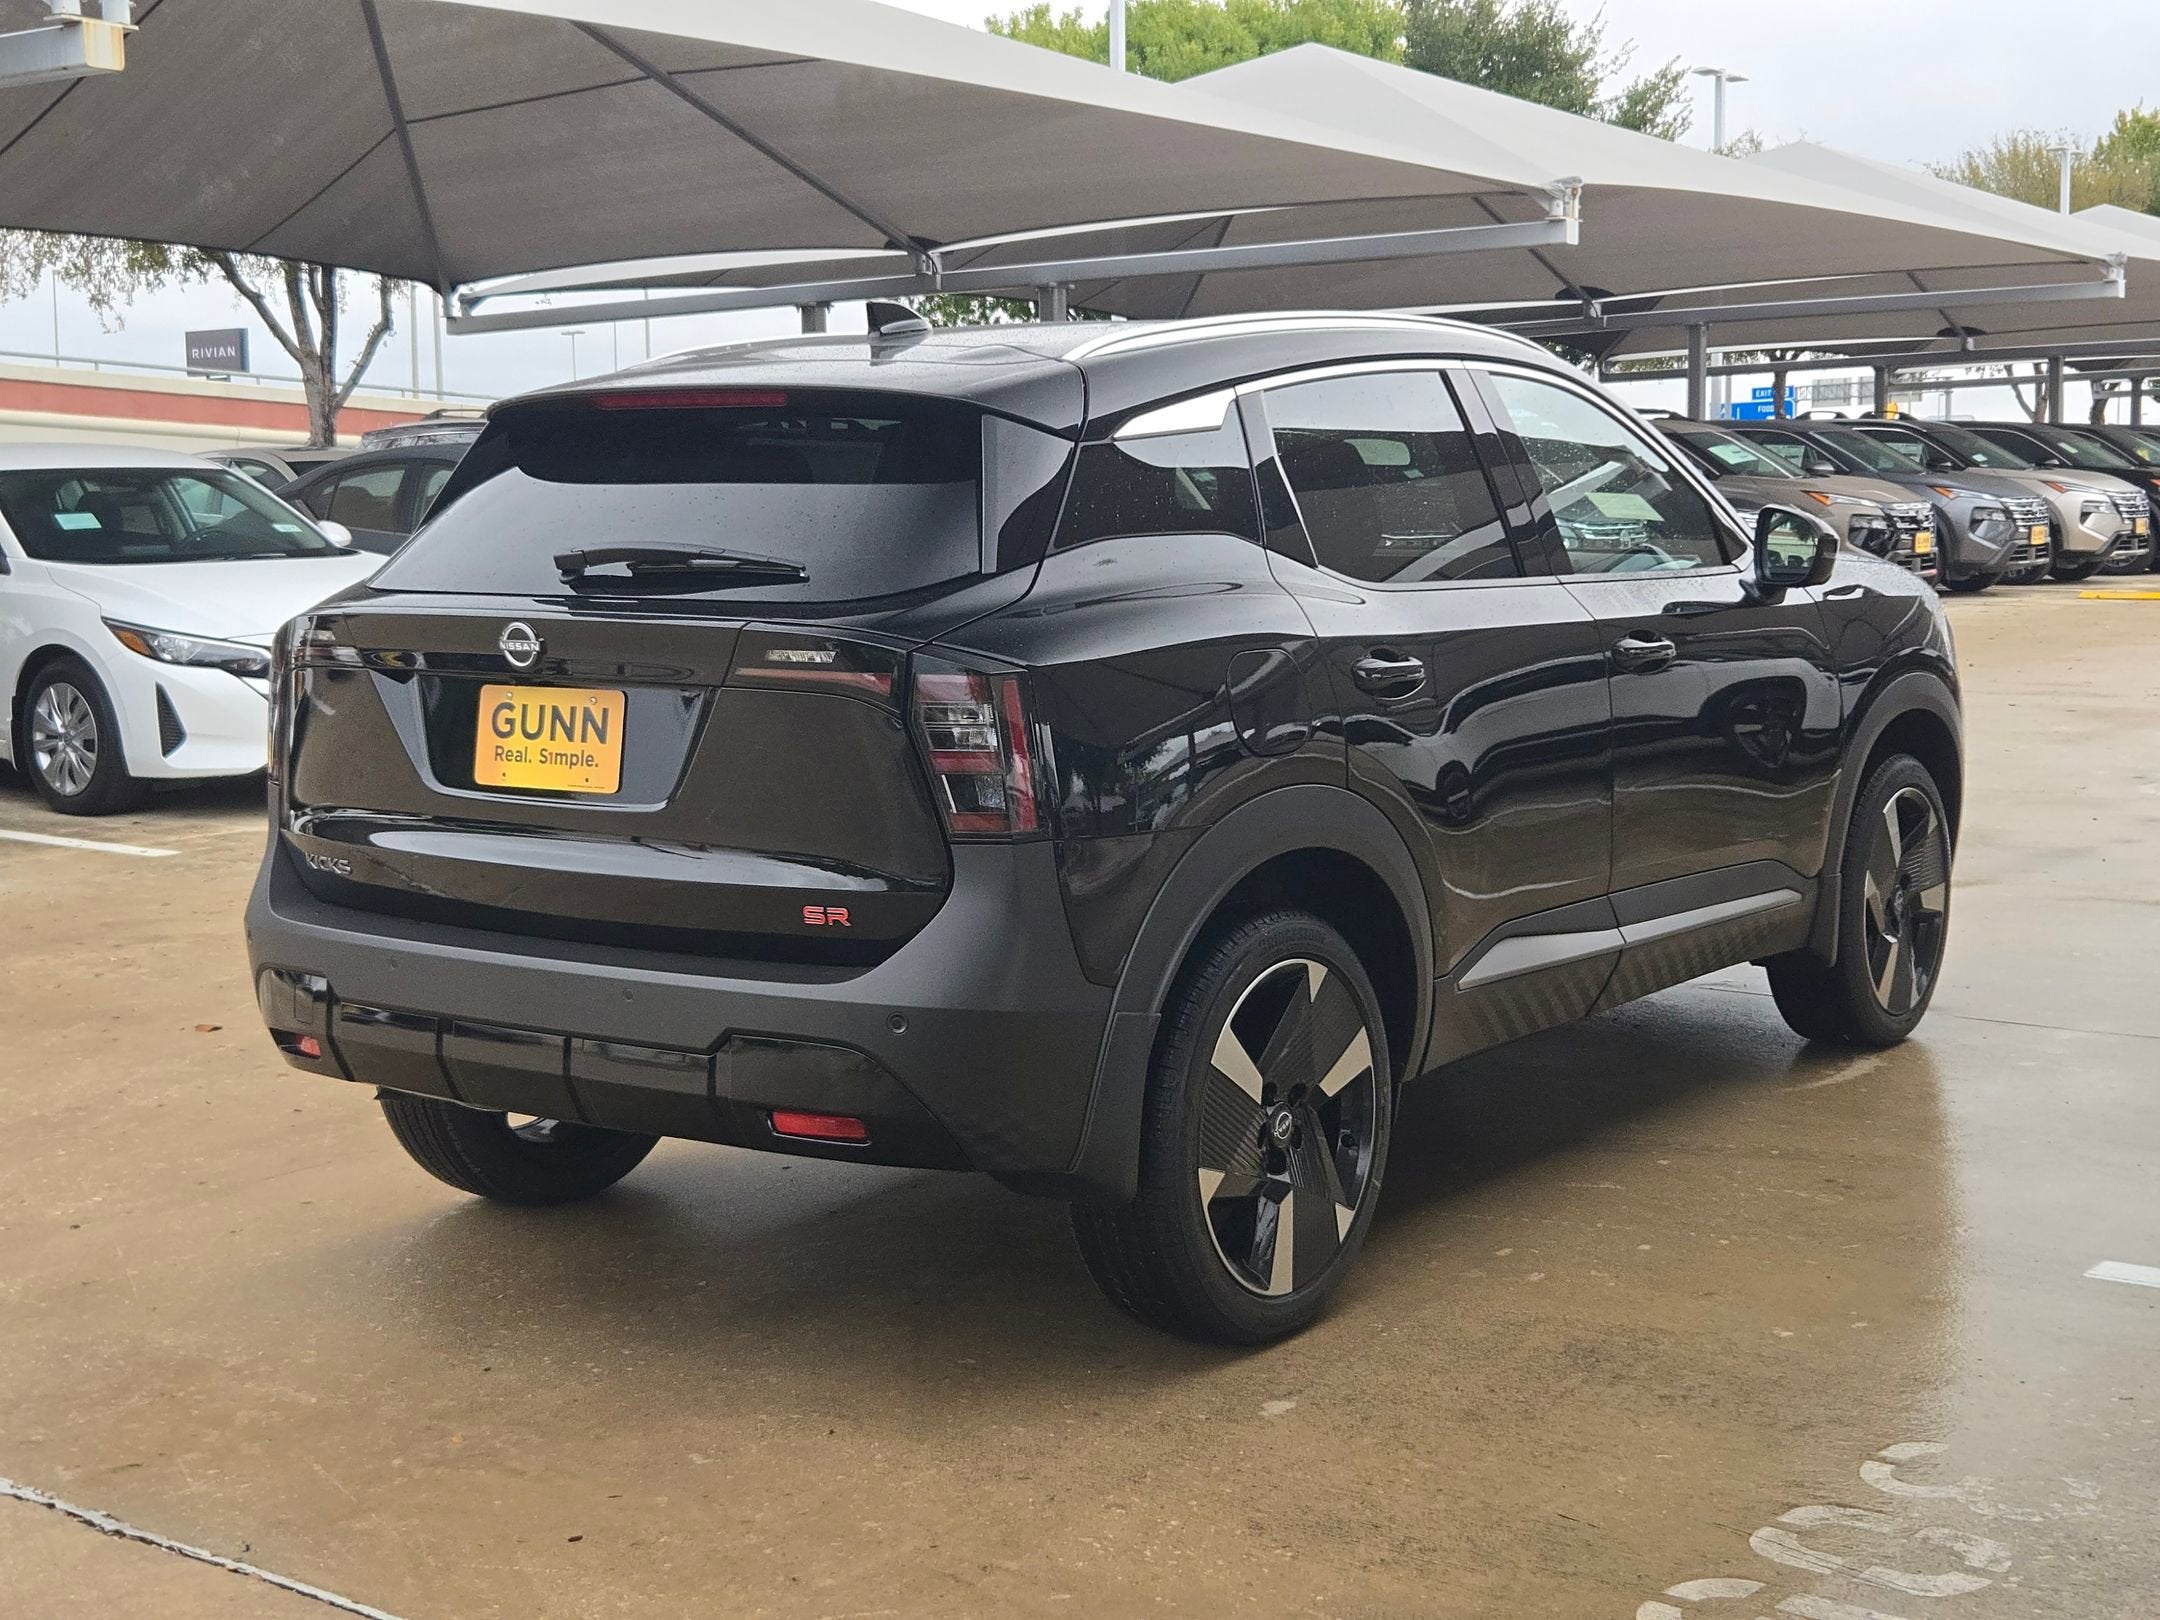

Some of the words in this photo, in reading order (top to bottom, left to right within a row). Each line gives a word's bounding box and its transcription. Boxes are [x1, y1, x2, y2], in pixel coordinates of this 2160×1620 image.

[192, 345, 236, 359] RIVIAN
[1755, 389, 1772, 398] EXIT
[499, 640, 540, 652] NISSAN
[491, 701, 610, 745] GUNN
[494, 745, 532, 763] Real.
[305, 852, 352, 875] KICKS
[802, 905, 852, 927] SR
